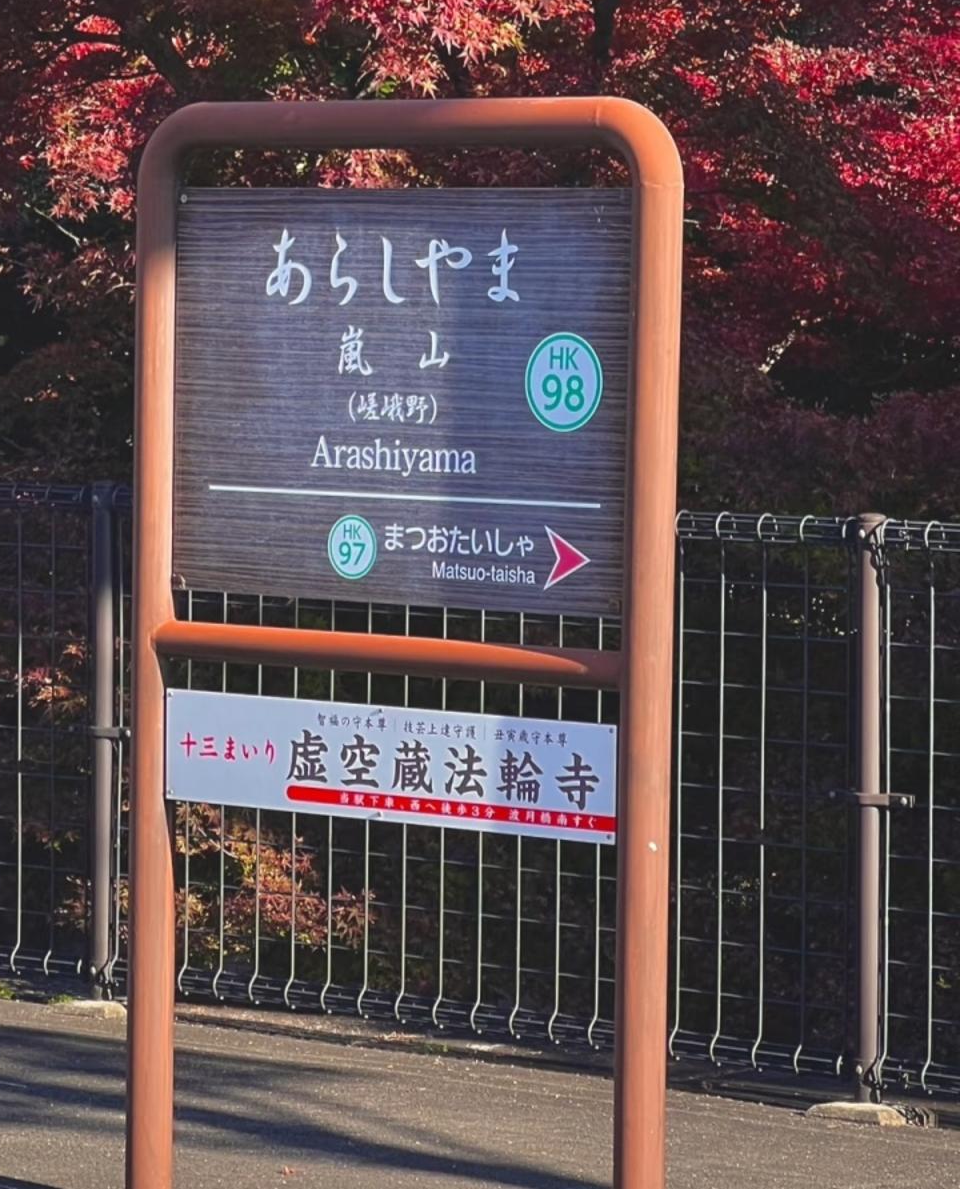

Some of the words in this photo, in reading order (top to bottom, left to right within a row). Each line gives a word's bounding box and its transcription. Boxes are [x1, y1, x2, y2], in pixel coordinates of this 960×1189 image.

[266, 227, 521, 305] あらしやま
[549, 347, 578, 370] HK
[349, 391, 437, 424] (嵯峨野)
[542, 374, 585, 412] 98
[311, 435, 477, 476] Arashiyama
[343, 523, 361, 539] HK
[384, 524, 534, 558] まつおたいしゃ
[339, 541, 365, 566] 97
[432, 560, 536, 585] Matsuo-taisha
[180, 731, 275, 764] 十三まいり
[286, 729, 600, 810] 虚空蔵法輪寺
